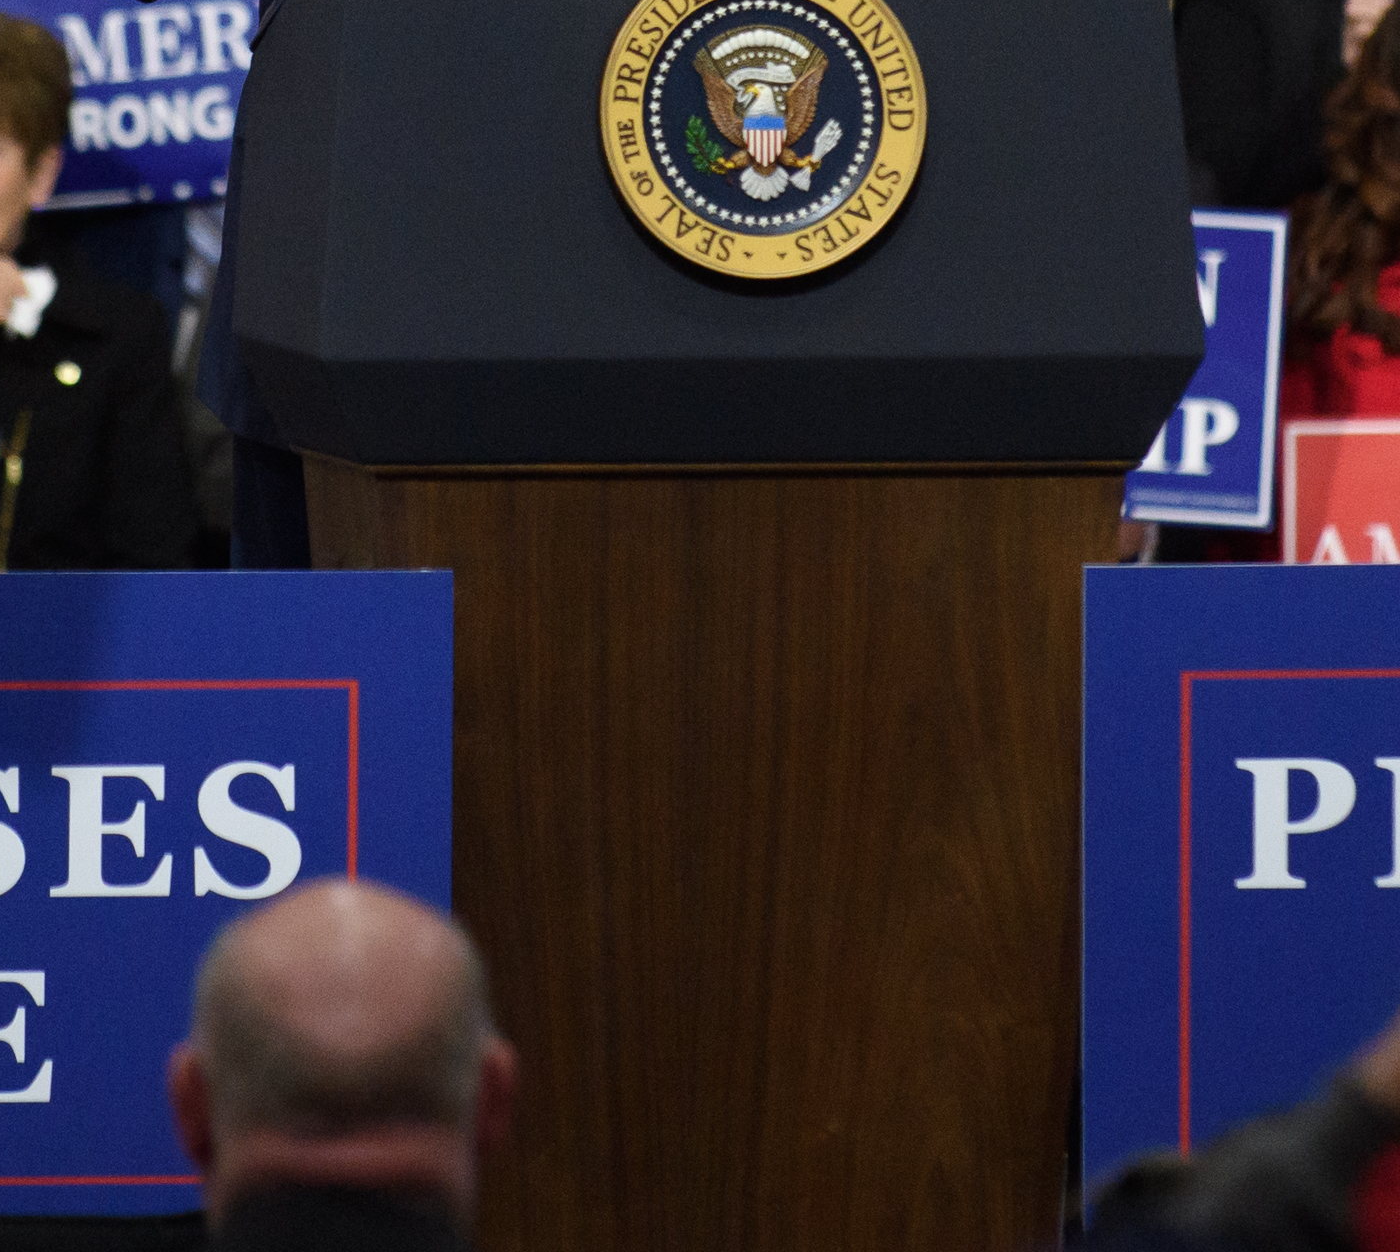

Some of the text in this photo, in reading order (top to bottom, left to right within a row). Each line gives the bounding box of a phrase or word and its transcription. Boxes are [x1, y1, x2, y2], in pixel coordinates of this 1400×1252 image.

[847, 0, 916, 132] UNITED
[618, 117, 642, 161] THE
[630, 168, 655, 198] OF
[794, 161, 902, 263] STATES
[651, 193, 737, 263] SEAL
